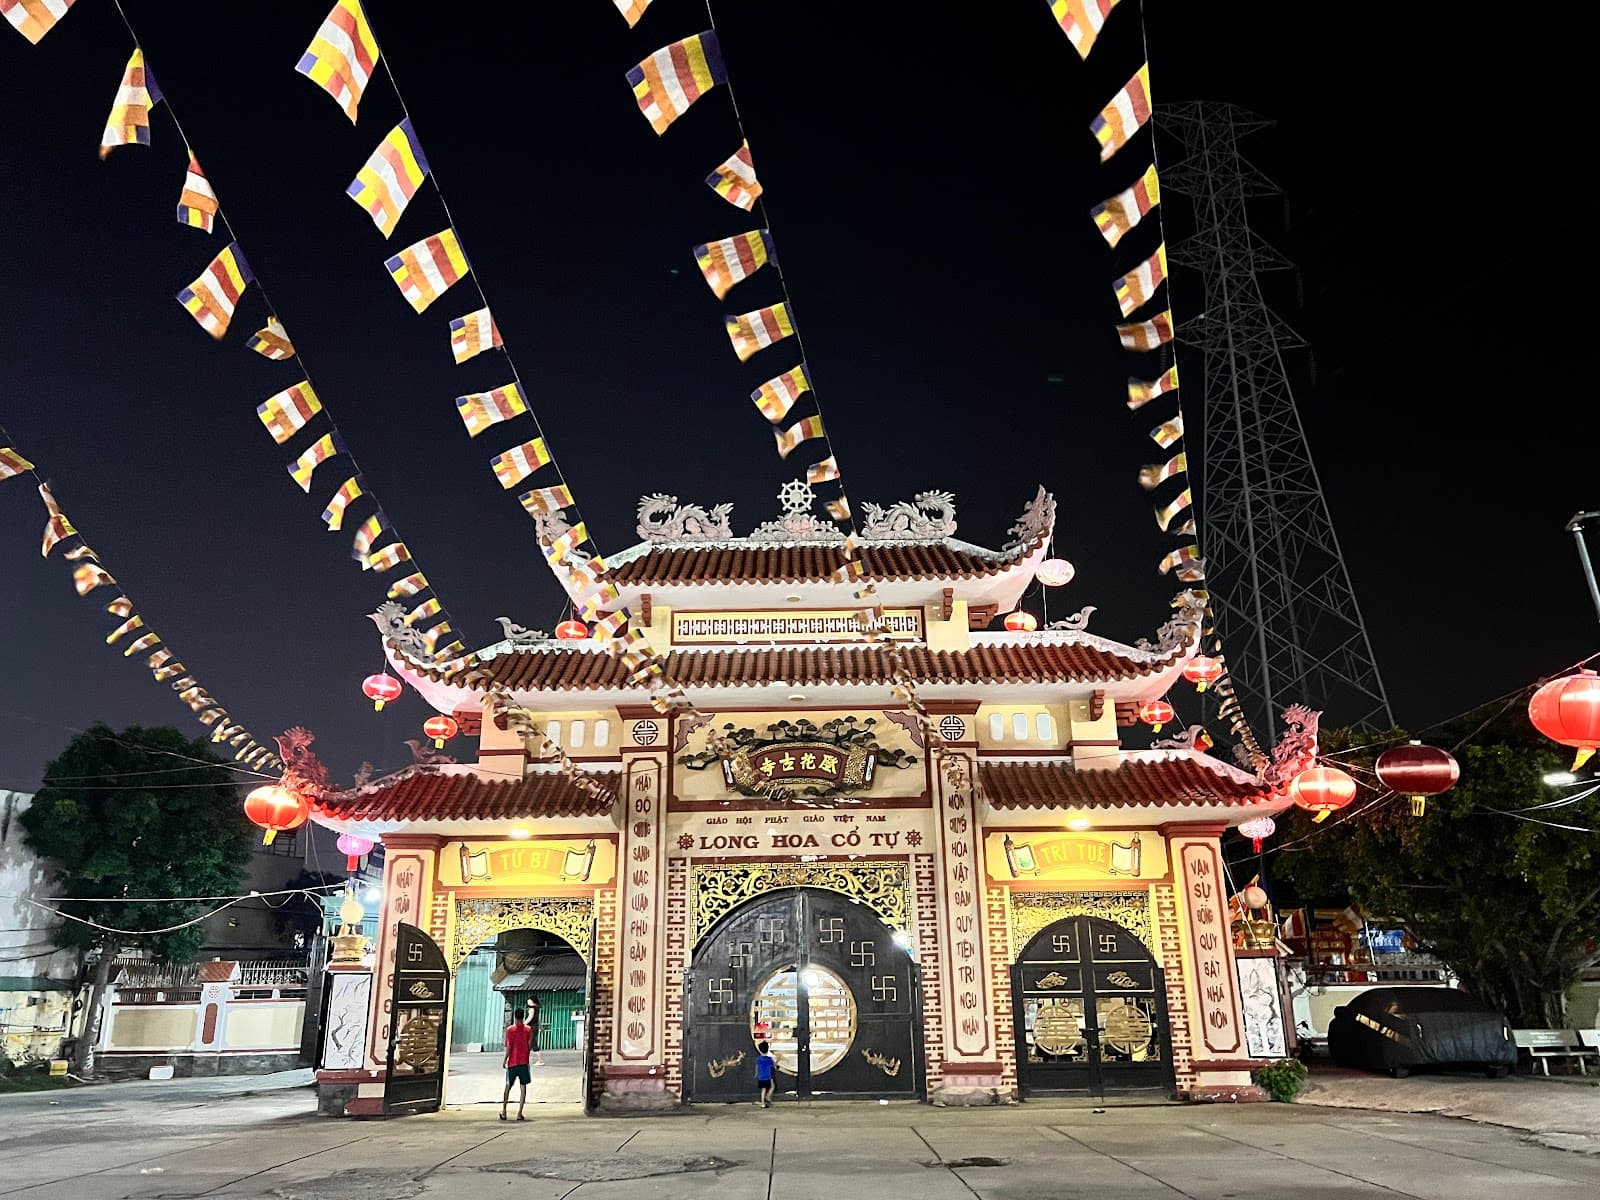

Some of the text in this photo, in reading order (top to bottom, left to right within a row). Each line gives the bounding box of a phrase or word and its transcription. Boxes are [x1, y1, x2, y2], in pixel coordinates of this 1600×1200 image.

[706, 816, 728, 825] GIÁO
[736, 816, 752, 825] HỘI
[803, 814, 825, 822] GIÁO
[833, 814, 854, 823] VIỆT
[699, 826, 900, 850] LONG HOA CỔ TỰ
[1191, 858, 1210, 879] VẠN
[1194, 882, 1212, 903] SỰ
[1199, 932, 1217, 950] QUY
[1209, 1008, 1228, 1029] MÔN
